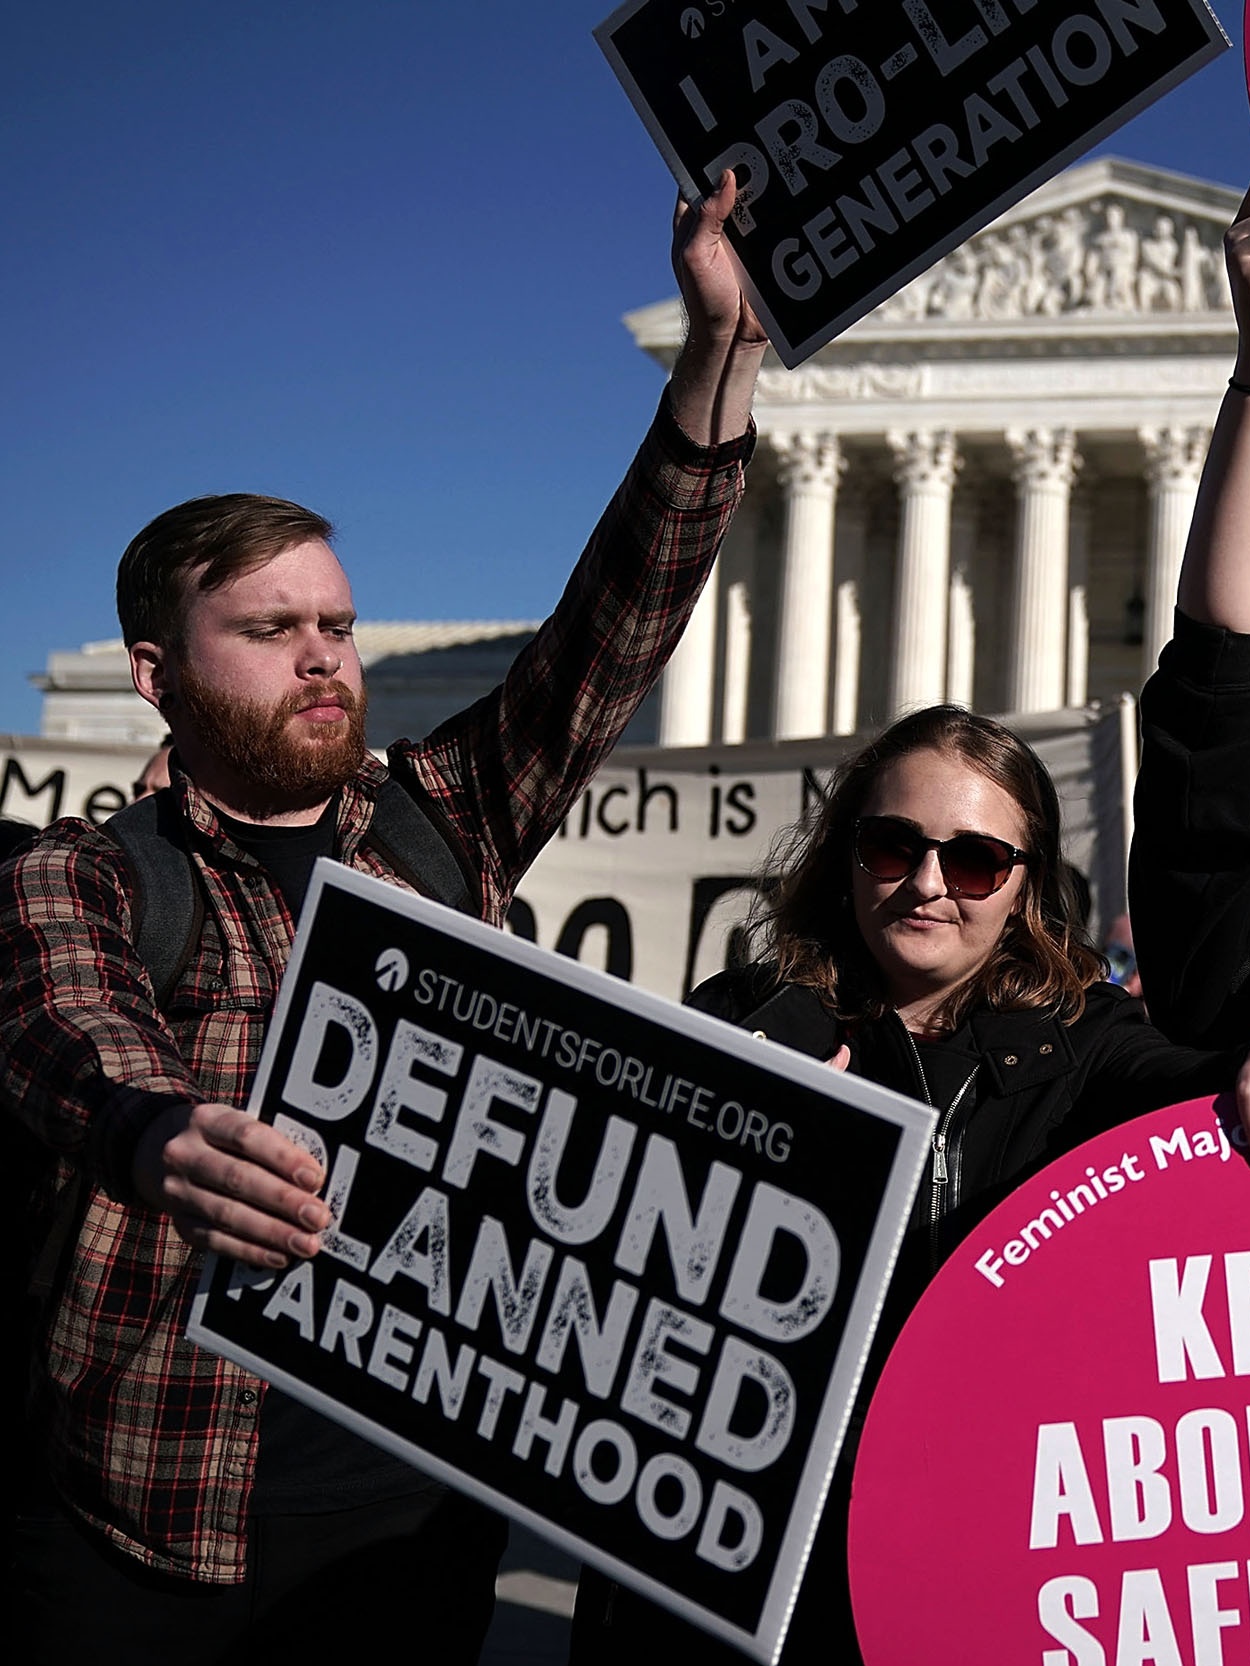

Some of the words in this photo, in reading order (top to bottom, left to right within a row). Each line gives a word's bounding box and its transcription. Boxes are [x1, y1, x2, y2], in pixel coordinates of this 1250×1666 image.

[678, 74, 719, 132] I
[771, 0, 1167, 302] GENERATION
[708, 766, 757, 838] is
[413, 968, 794, 1164] STUDENTSFORLIFE.ORG
[281, 980, 841, 1343] DEFUND
[974, 1153, 1146, 1289] Feminist
